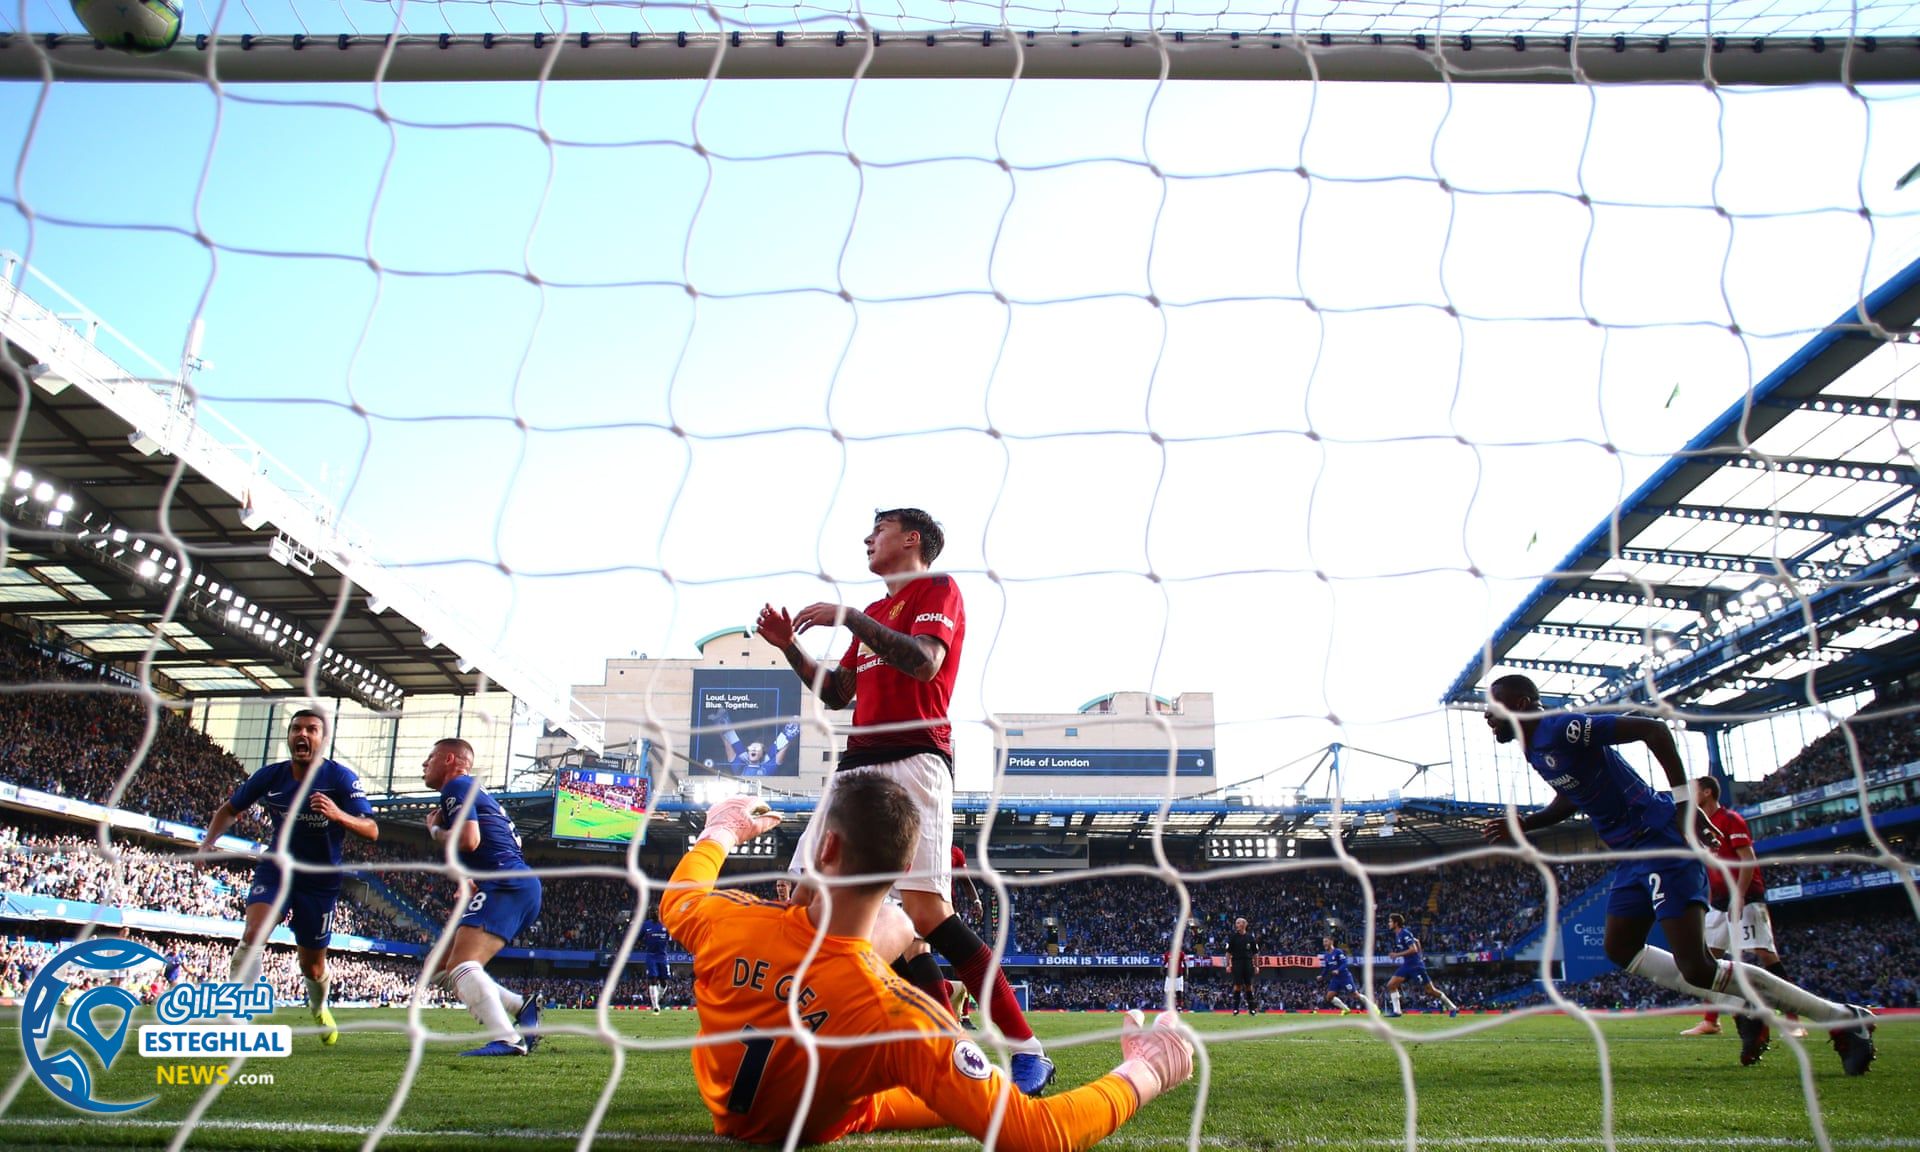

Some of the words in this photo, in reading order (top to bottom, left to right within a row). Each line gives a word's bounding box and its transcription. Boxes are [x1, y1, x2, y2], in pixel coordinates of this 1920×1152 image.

[914, 612, 954, 630] KOHLER
[705, 701, 723, 709] Blue.
[724, 701, 759, 710] Together.
[727, 694, 750, 702] Loyal.
[1009, 757, 1036, 767] Pride
[1038, 757, 1049, 767] of
[1051, 758, 1090, 767] London
[1648, 872, 1665, 900] 2
[468, 891, 487, 912] 8
[1743, 925, 1756, 941] 31
[1046, 956, 1077, 965] BORN
[1081, 956, 1092, 965] IS
[1095, 956, 1118, 965] THE
[1122, 956, 1150, 965] KING
[1277, 956, 1313, 967] LEGEND
[732, 957, 770, 993] DE
[726, 1023, 777, 1114] 1
